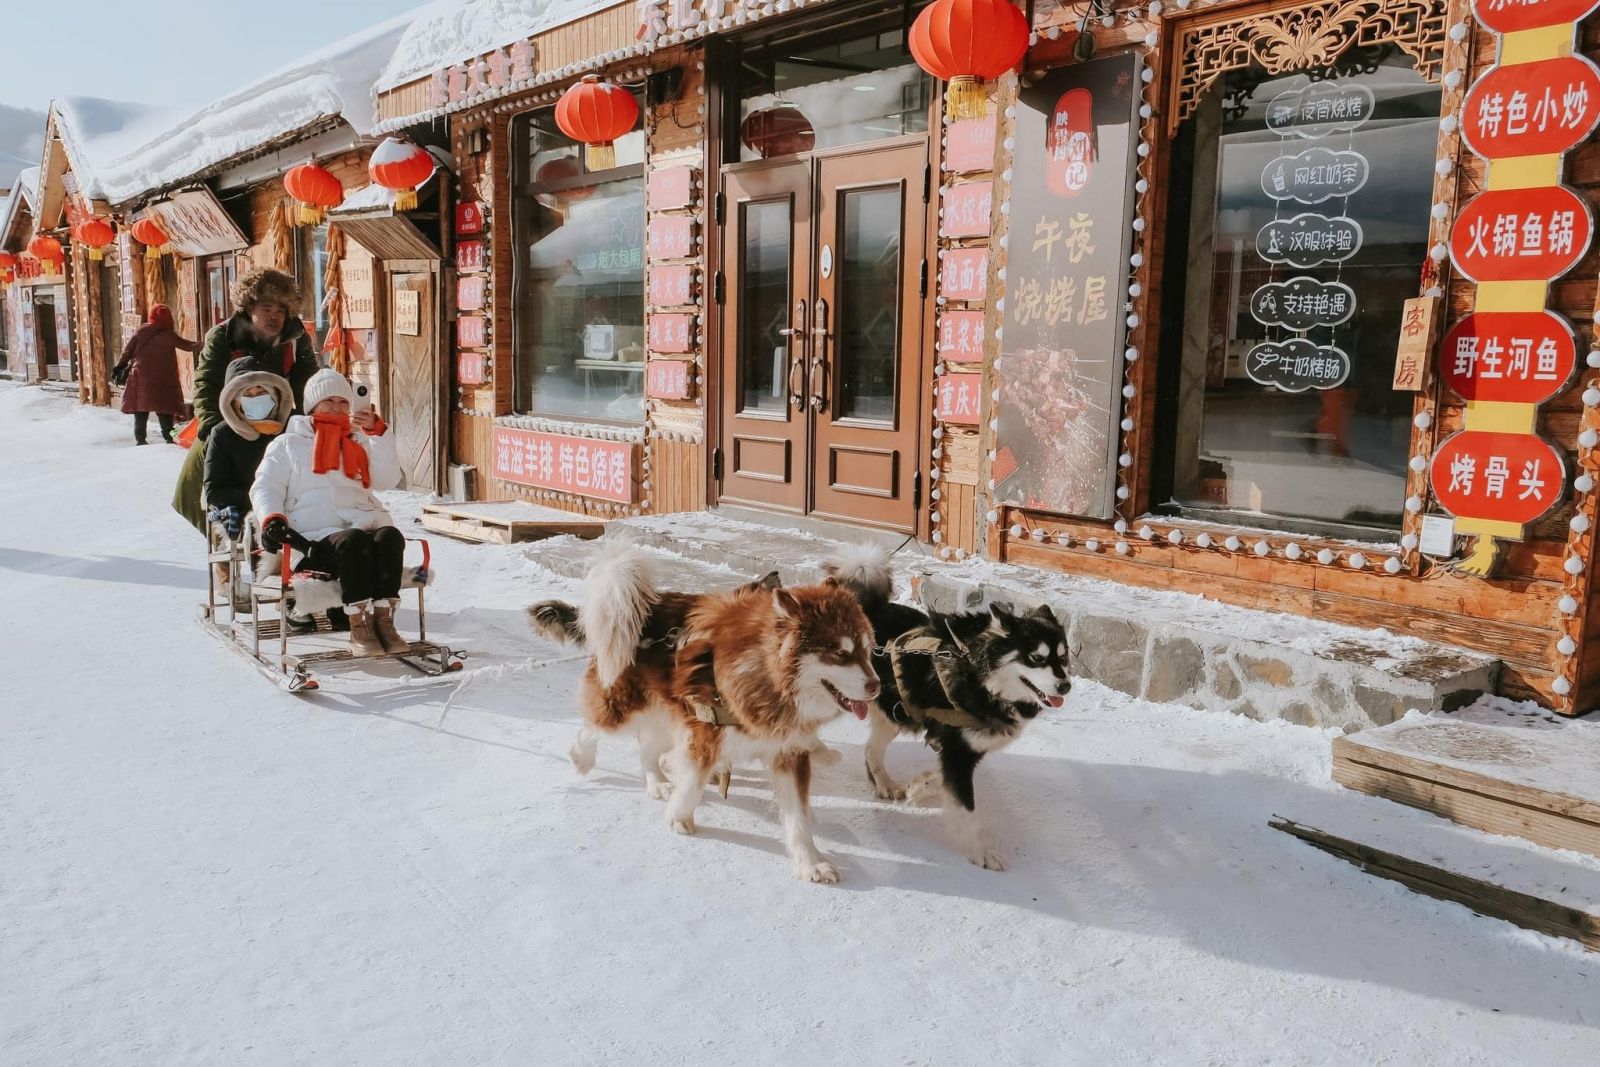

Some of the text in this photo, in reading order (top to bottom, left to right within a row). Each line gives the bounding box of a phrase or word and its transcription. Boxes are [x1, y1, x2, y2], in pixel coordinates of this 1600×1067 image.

[1301, 96, 1362, 121] 夜宵烧烤
[1478, 81, 1588, 138] 特色小炒
[1295, 161, 1359, 186] 网红奶茶
[1032, 211, 1096, 263] 午夜
[1289, 230, 1353, 252] 汉服体验
[1465, 210, 1575, 258] 火锅鱼锅
[1014, 275, 1108, 327] 烧烤屋
[1283, 293, 1347, 316] 支持艳遇
[1279, 356, 1341, 379] 牛奶烤肠
[1396, 306, 1425, 388] 客房
[1453, 336, 1558, 380] 野生河鱼
[497, 433, 625, 494] 滋滋羊排 特色烧烤
[1449, 453, 1546, 501] 烤骨头
